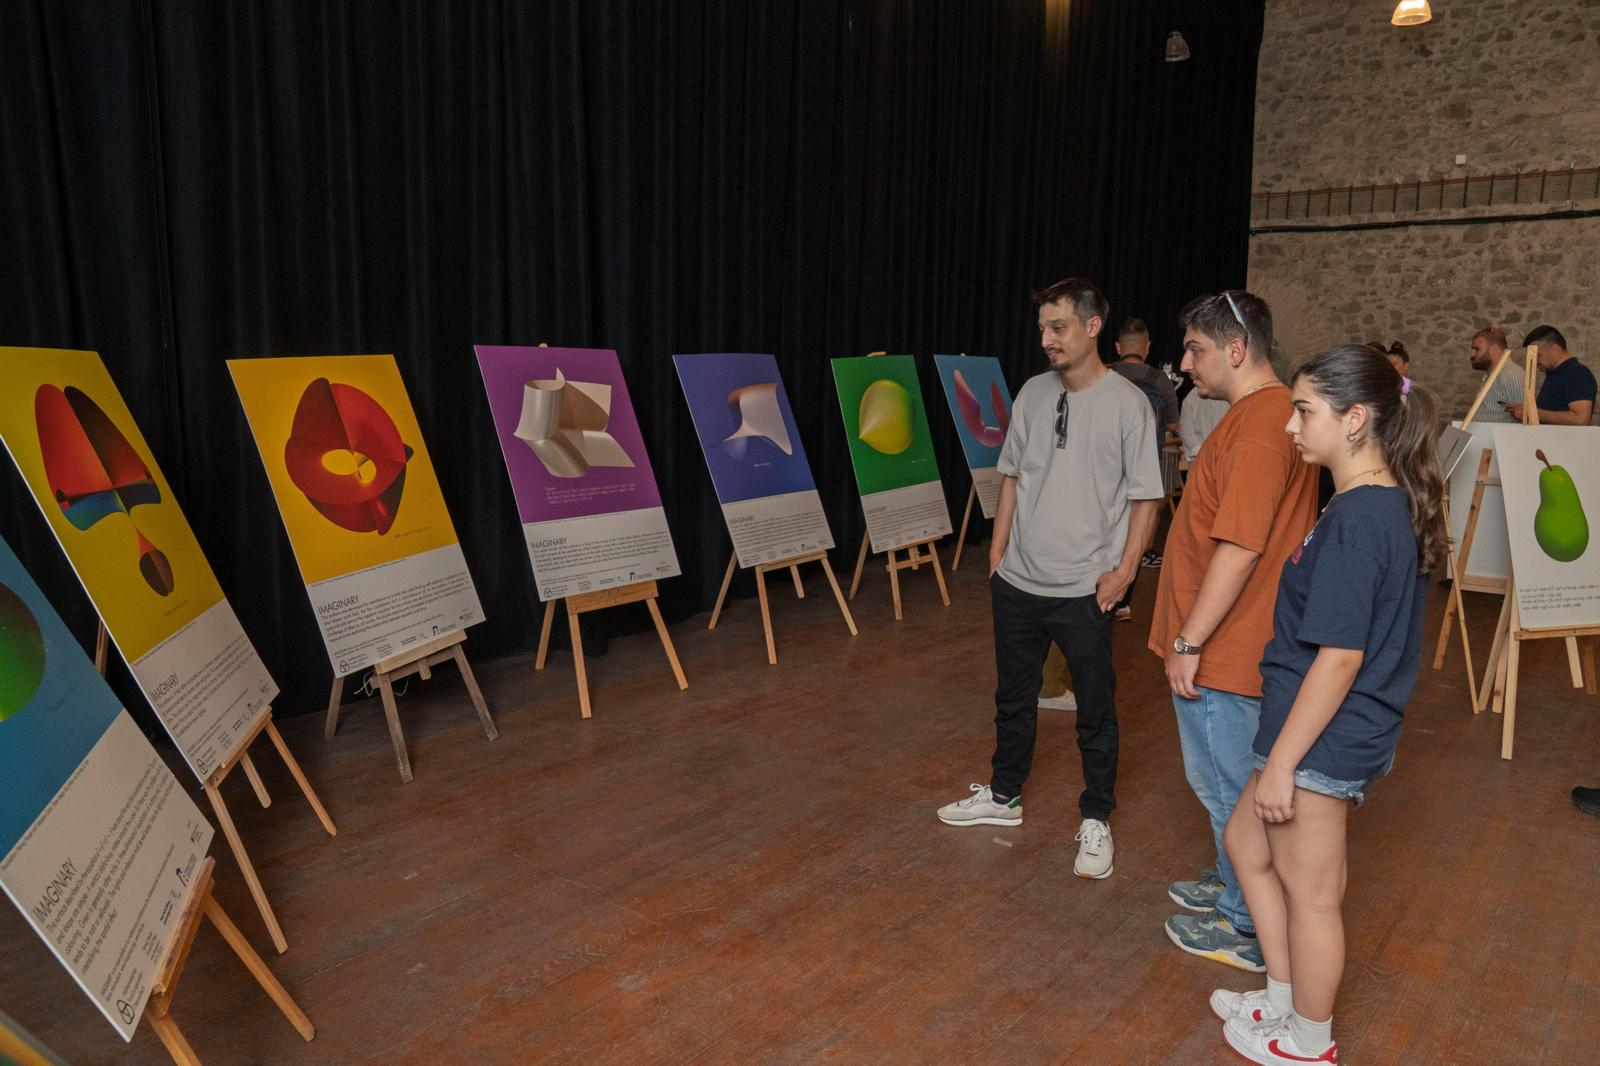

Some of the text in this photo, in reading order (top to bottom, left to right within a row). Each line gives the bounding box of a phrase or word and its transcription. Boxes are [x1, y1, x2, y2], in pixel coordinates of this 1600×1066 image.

[531, 538, 567, 548] IMAGINARY
[318, 595, 360, 614] IMAGINARY
[150, 672, 178, 702] IMAGINARY
[34, 857, 78, 923] IMAGINARY
